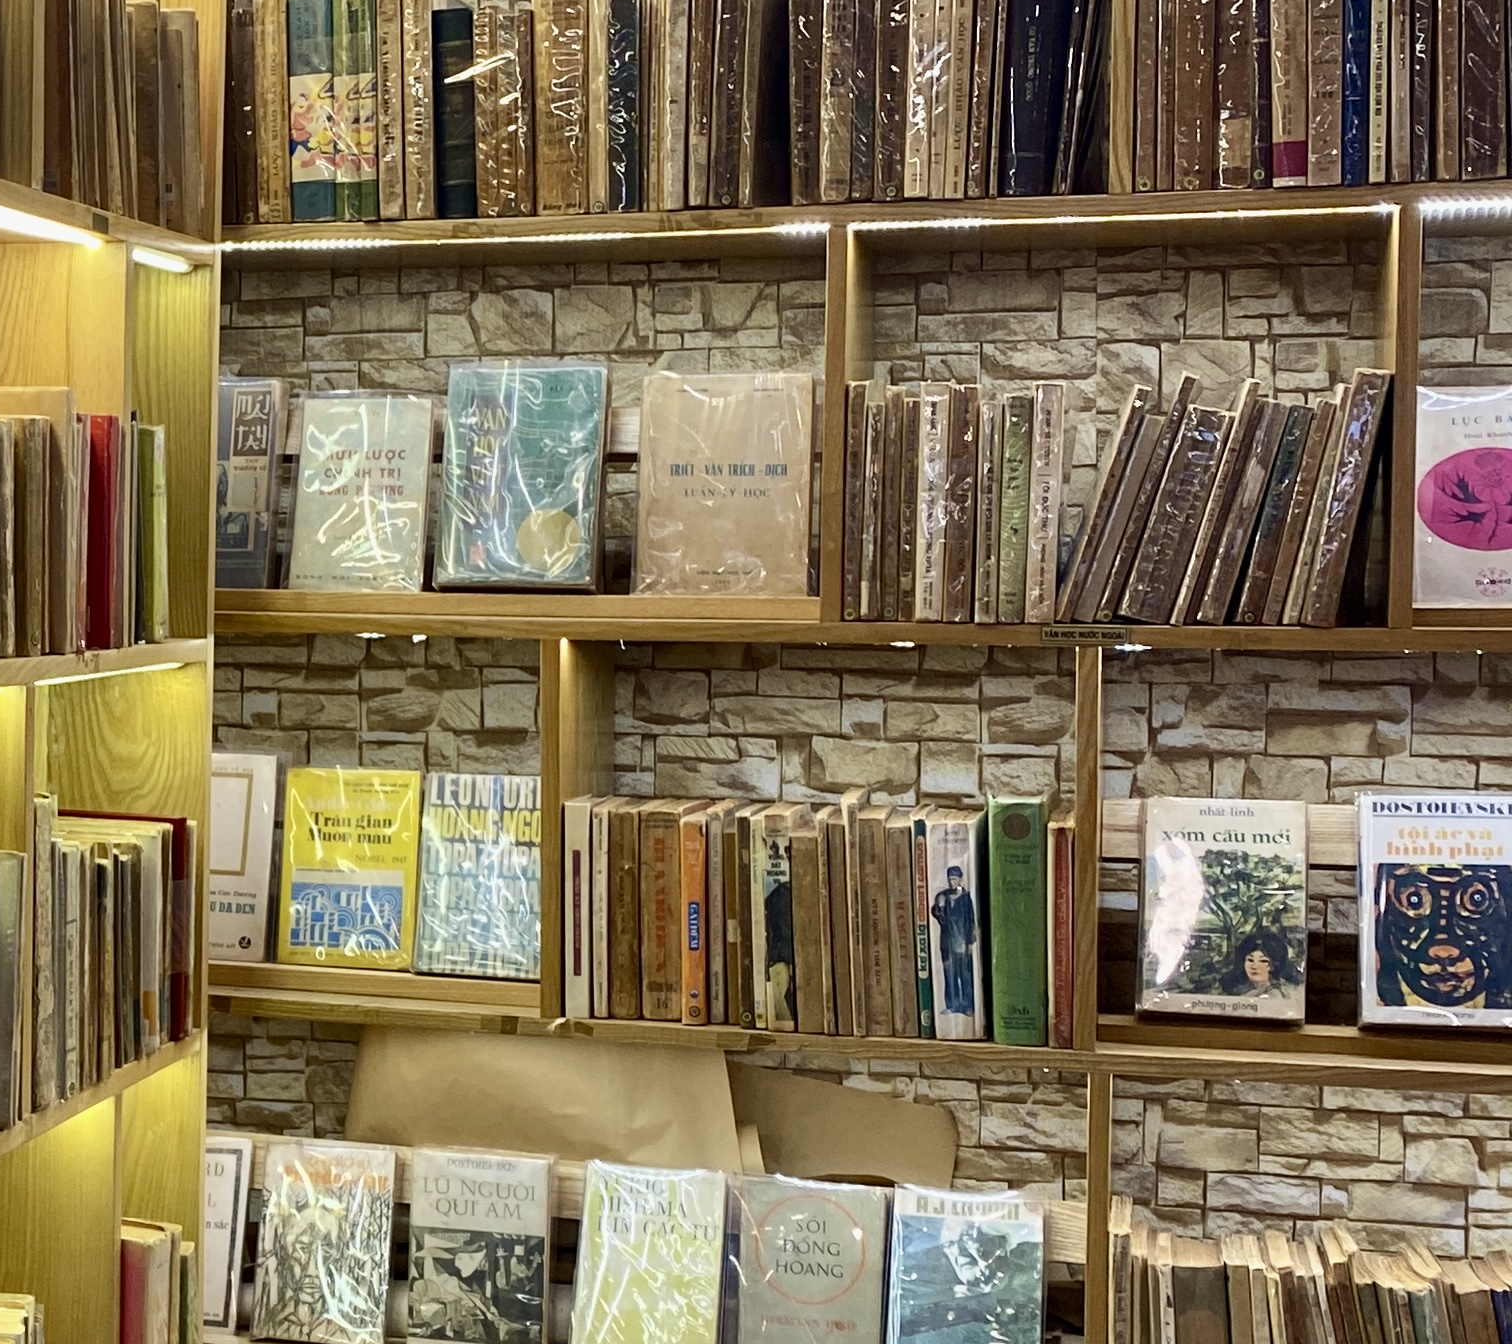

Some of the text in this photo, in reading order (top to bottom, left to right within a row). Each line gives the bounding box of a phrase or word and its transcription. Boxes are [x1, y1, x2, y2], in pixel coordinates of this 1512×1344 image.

[1451, 414, 1484, 430] LỤC
[379, 467, 402, 481] TRỊ
[1043, 627, 1126, 640] VĂN HỌC NƯỚC NGOÀI
[354, 812, 393, 831] gian
[1161, 825, 1292, 845] xóm cầu mới
[1434, 825, 1463, 841] ác
[1467, 826, 1493, 840] và
[1386, 840, 1504, 861] hình phạt
[916, 841, 925, 885] camus
[458, 1177, 538, 1203] NGƯỜI
[775, 1258, 845, 1280] HOANG
